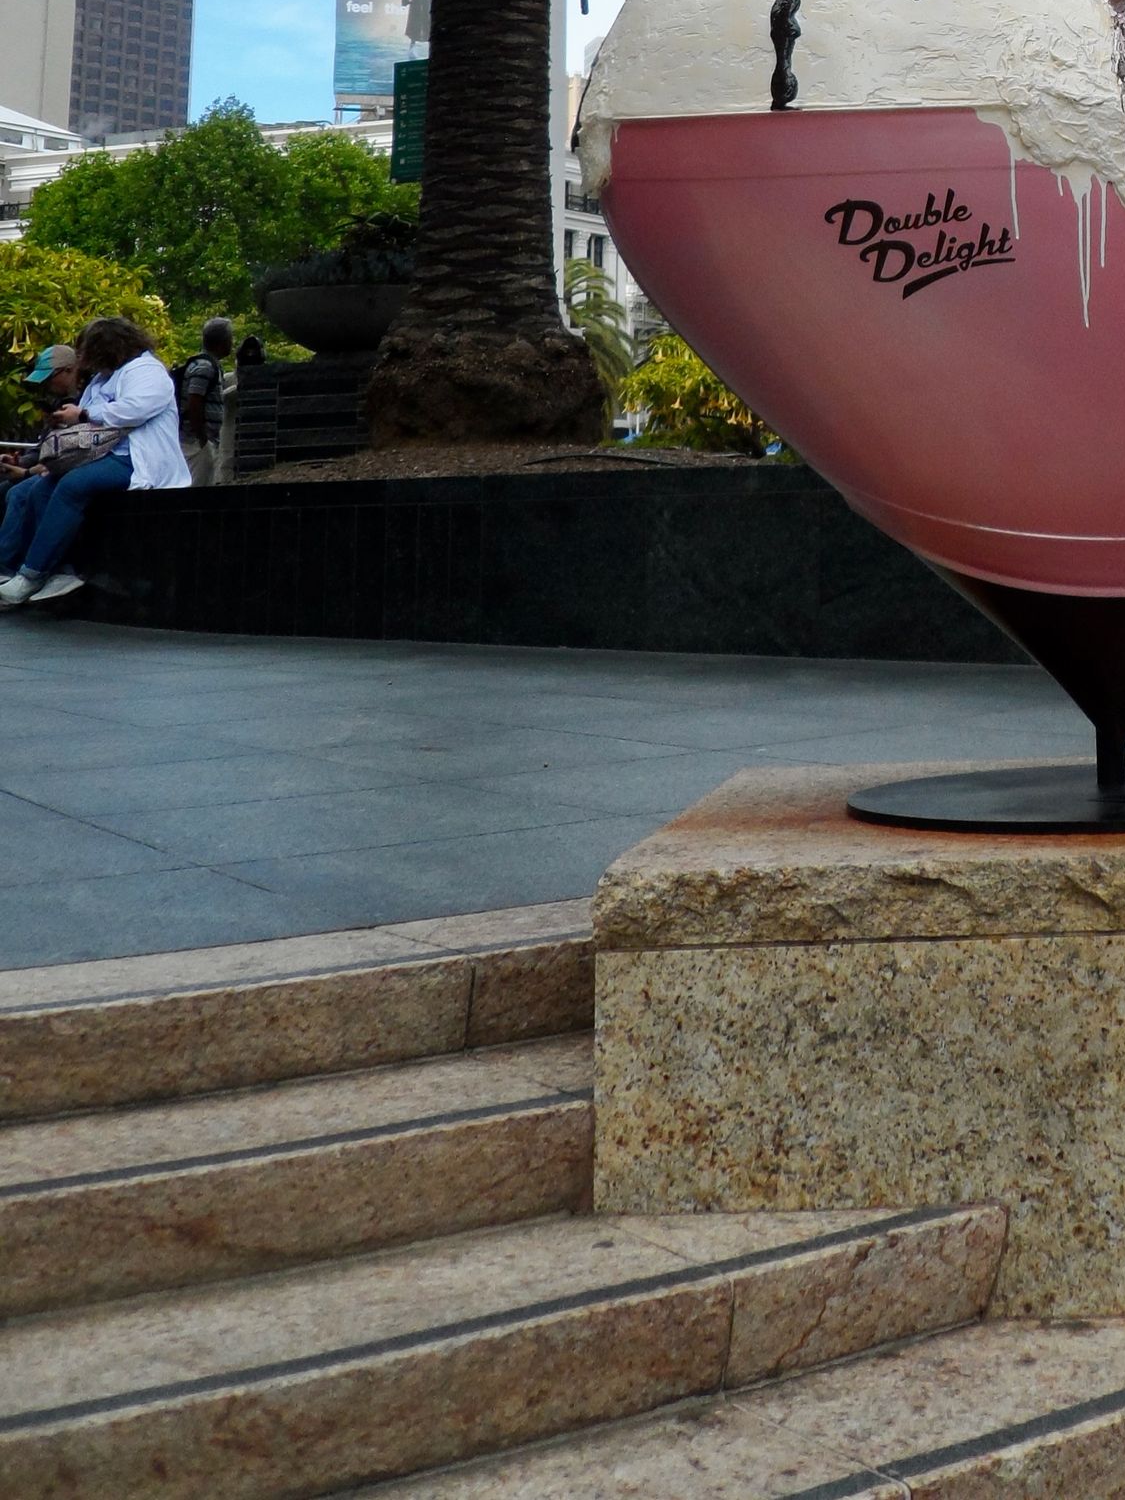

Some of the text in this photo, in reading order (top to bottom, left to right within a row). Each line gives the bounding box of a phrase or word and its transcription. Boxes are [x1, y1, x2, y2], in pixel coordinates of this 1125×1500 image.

[346, 0, 373, 14] feel
[824, 188, 973, 246] Double
[859, 222, 1013, 283] Delight
